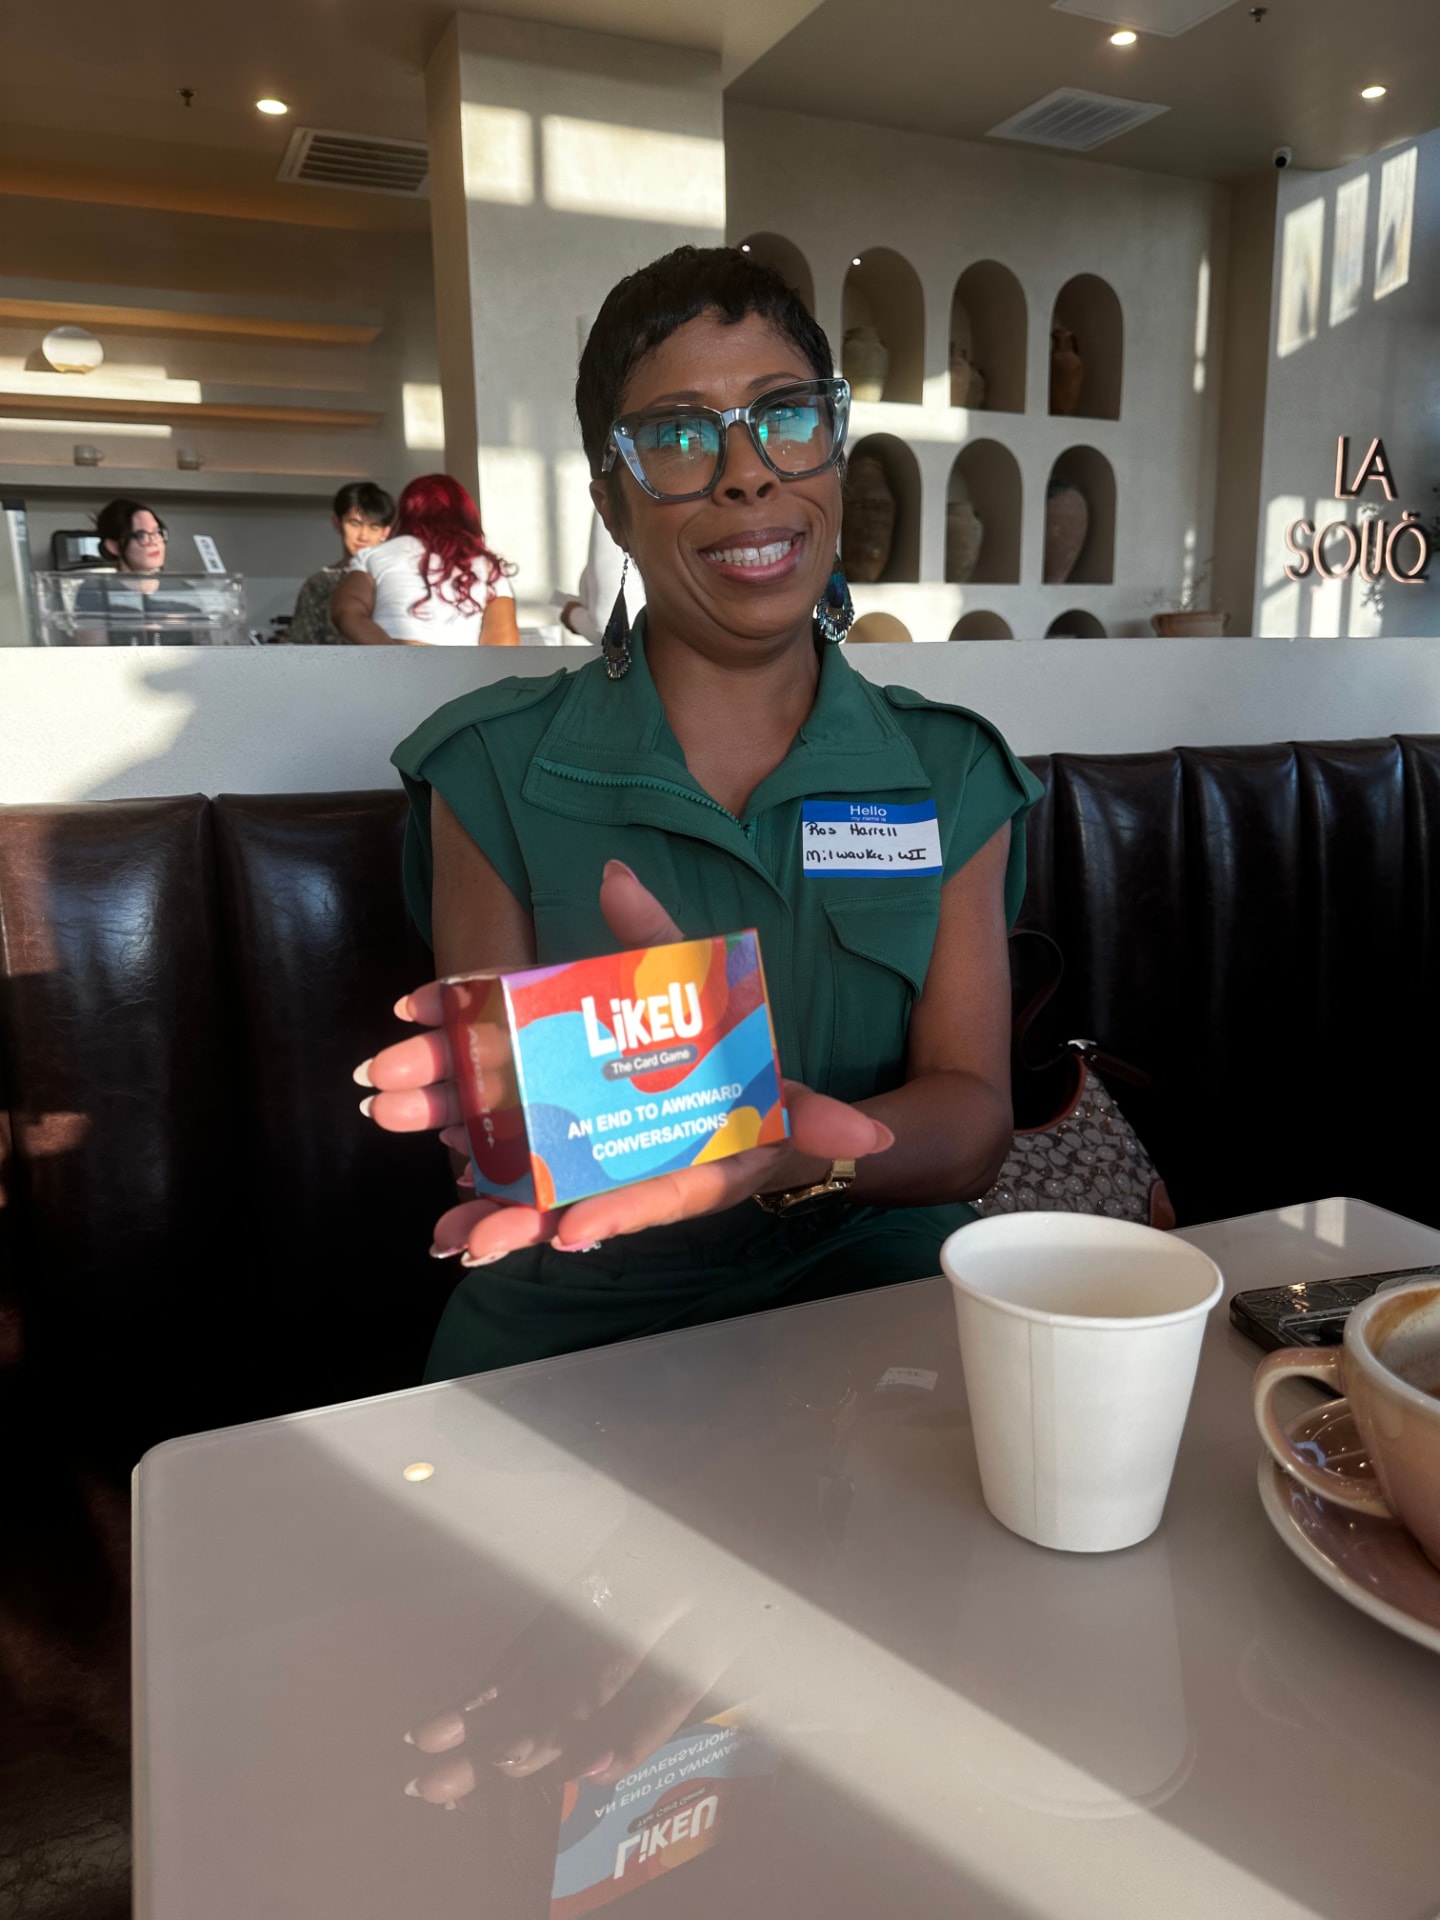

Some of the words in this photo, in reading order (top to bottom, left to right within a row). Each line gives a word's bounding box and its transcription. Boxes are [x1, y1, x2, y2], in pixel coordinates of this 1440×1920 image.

[1335, 435, 1398, 501] LA
[850, 805, 887, 817] Hello
[850, 823, 898, 837] Harrell
[898, 848, 927, 861] WI
[612, 1060, 632, 1075] The
[633, 1054, 659, 1071] Card
[660, 1049, 690, 1065] Game
[568, 1118, 594, 1140] AN
[596, 1109, 632, 1132] END
[635, 1102, 658, 1122] TO
[661, 1083, 743, 1117] AWKWARD
[592, 1113, 729, 1161] CONVERSATIONS
